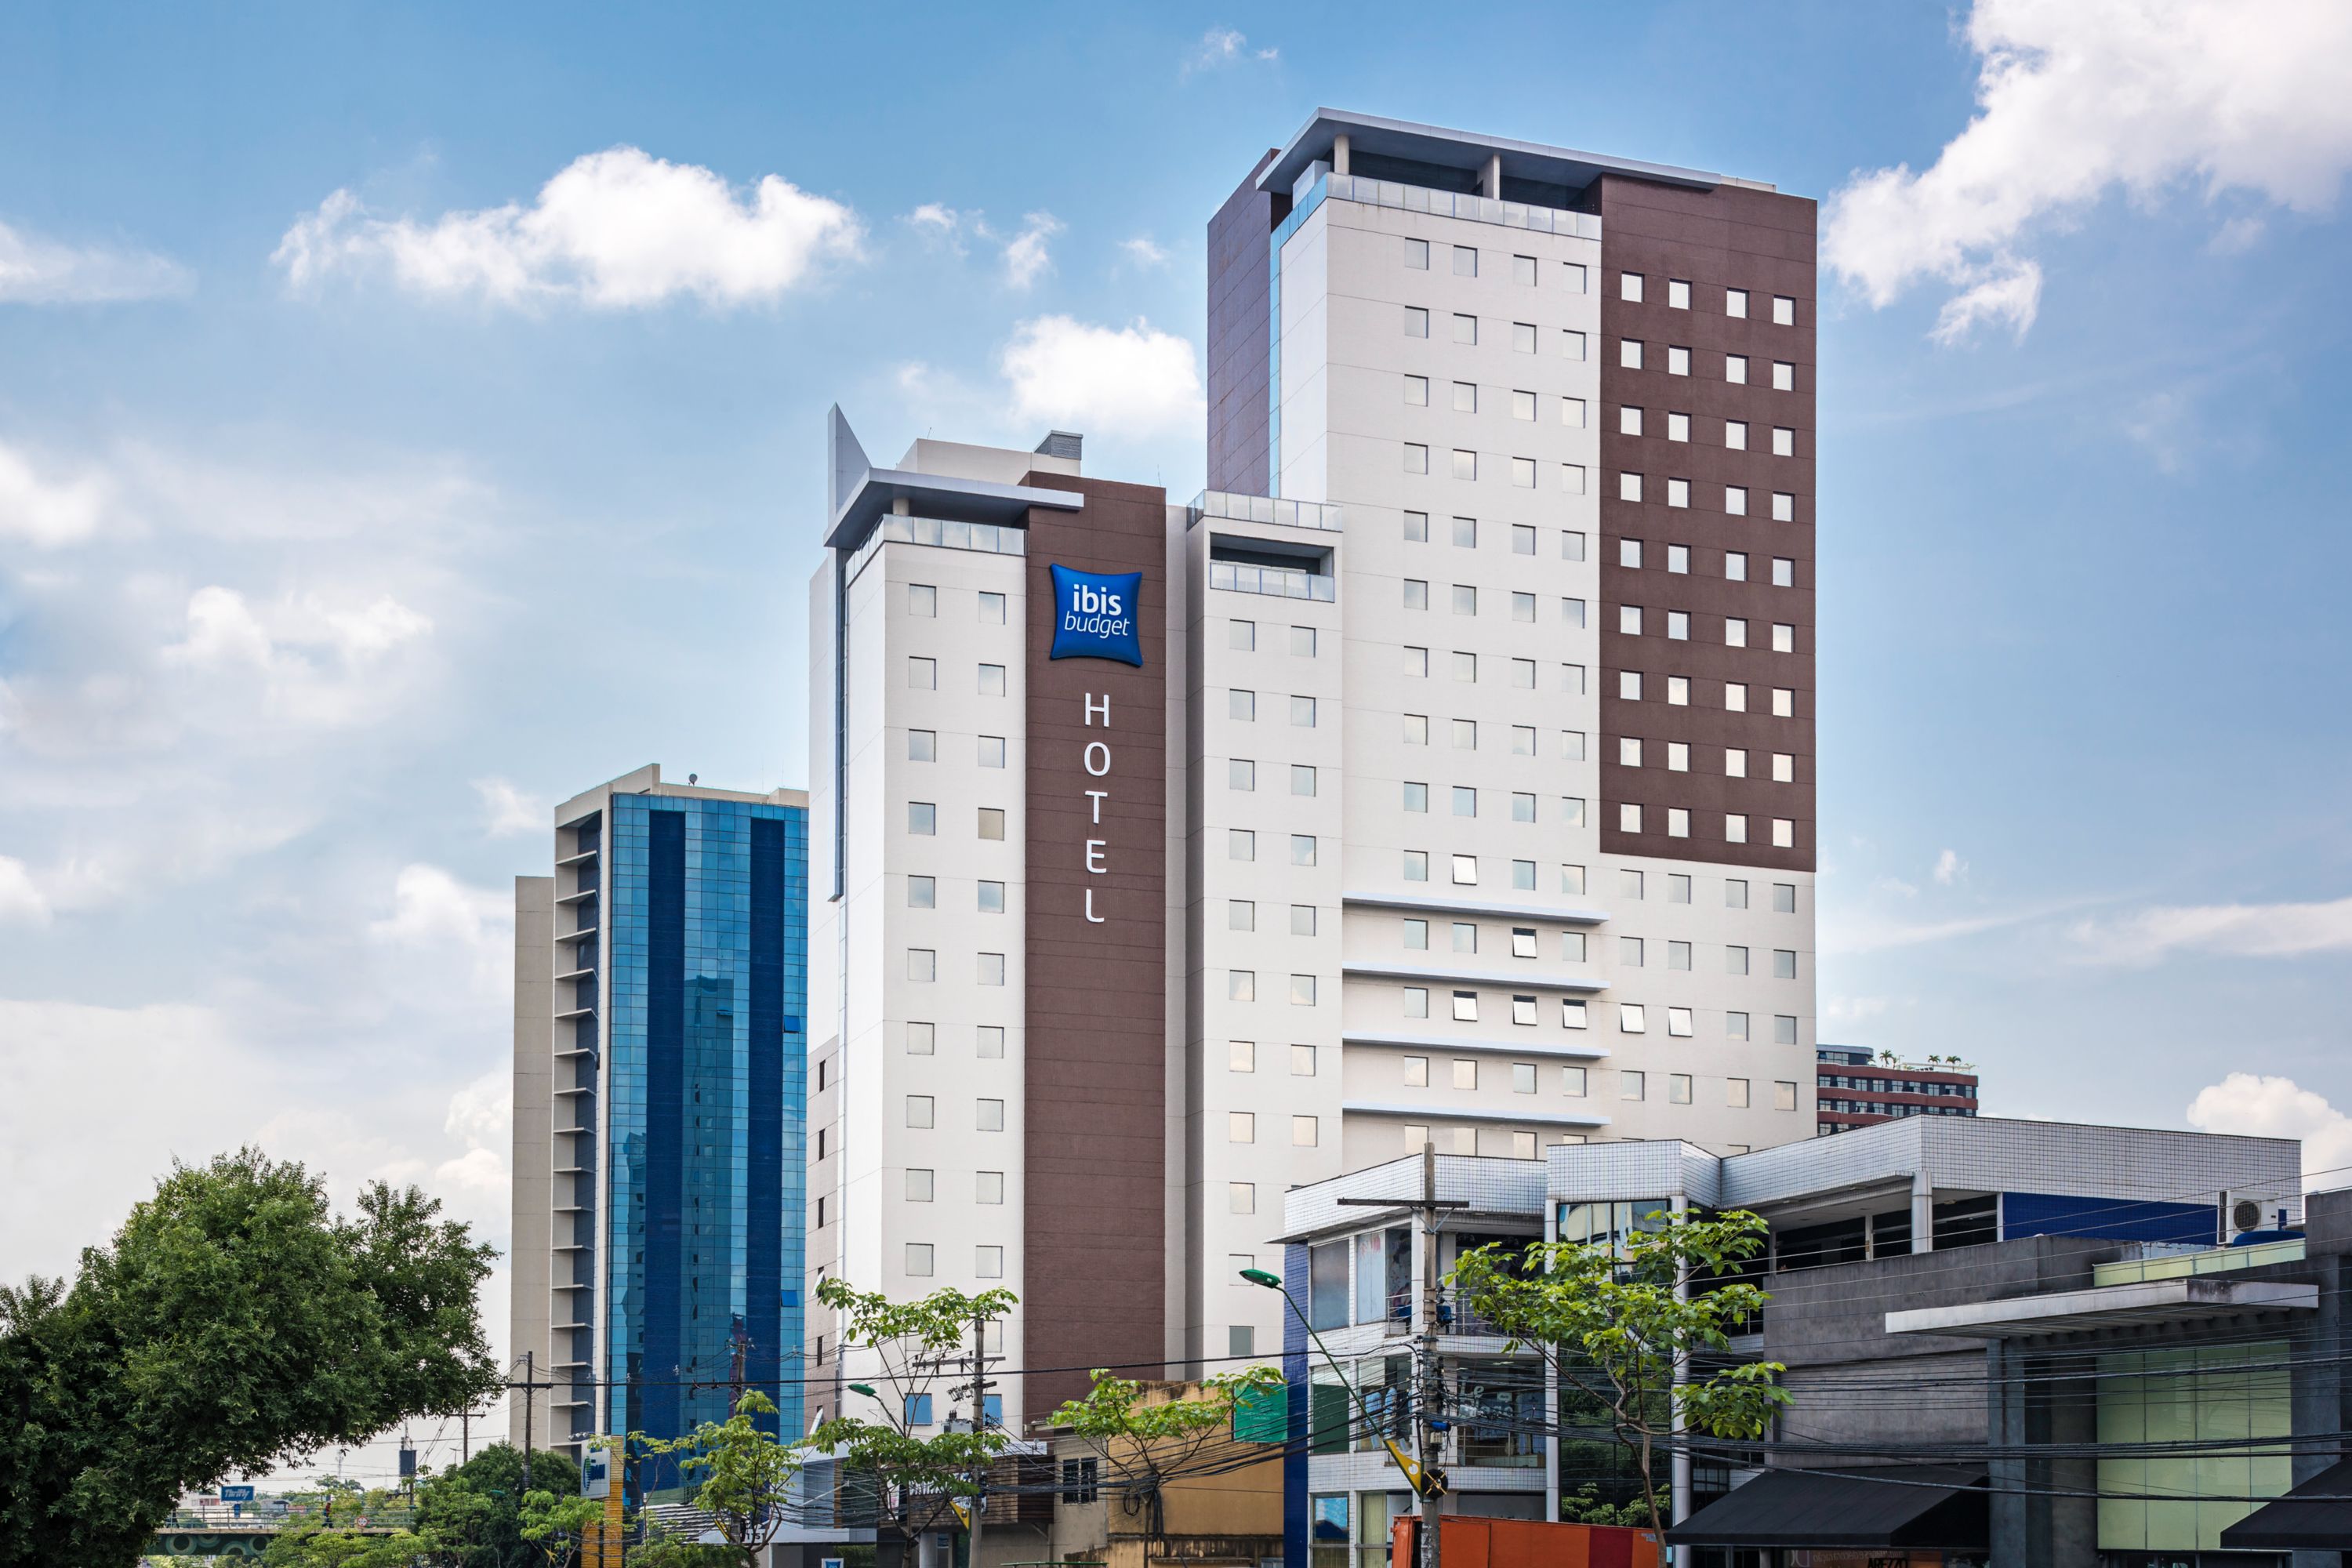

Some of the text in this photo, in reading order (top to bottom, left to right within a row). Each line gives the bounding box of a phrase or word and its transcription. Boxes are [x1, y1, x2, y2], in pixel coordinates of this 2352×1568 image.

[1073, 583, 1122, 616] ibis
[1064, 611, 1131, 639] budget
[1083, 692, 1111, 923] HOTEL
